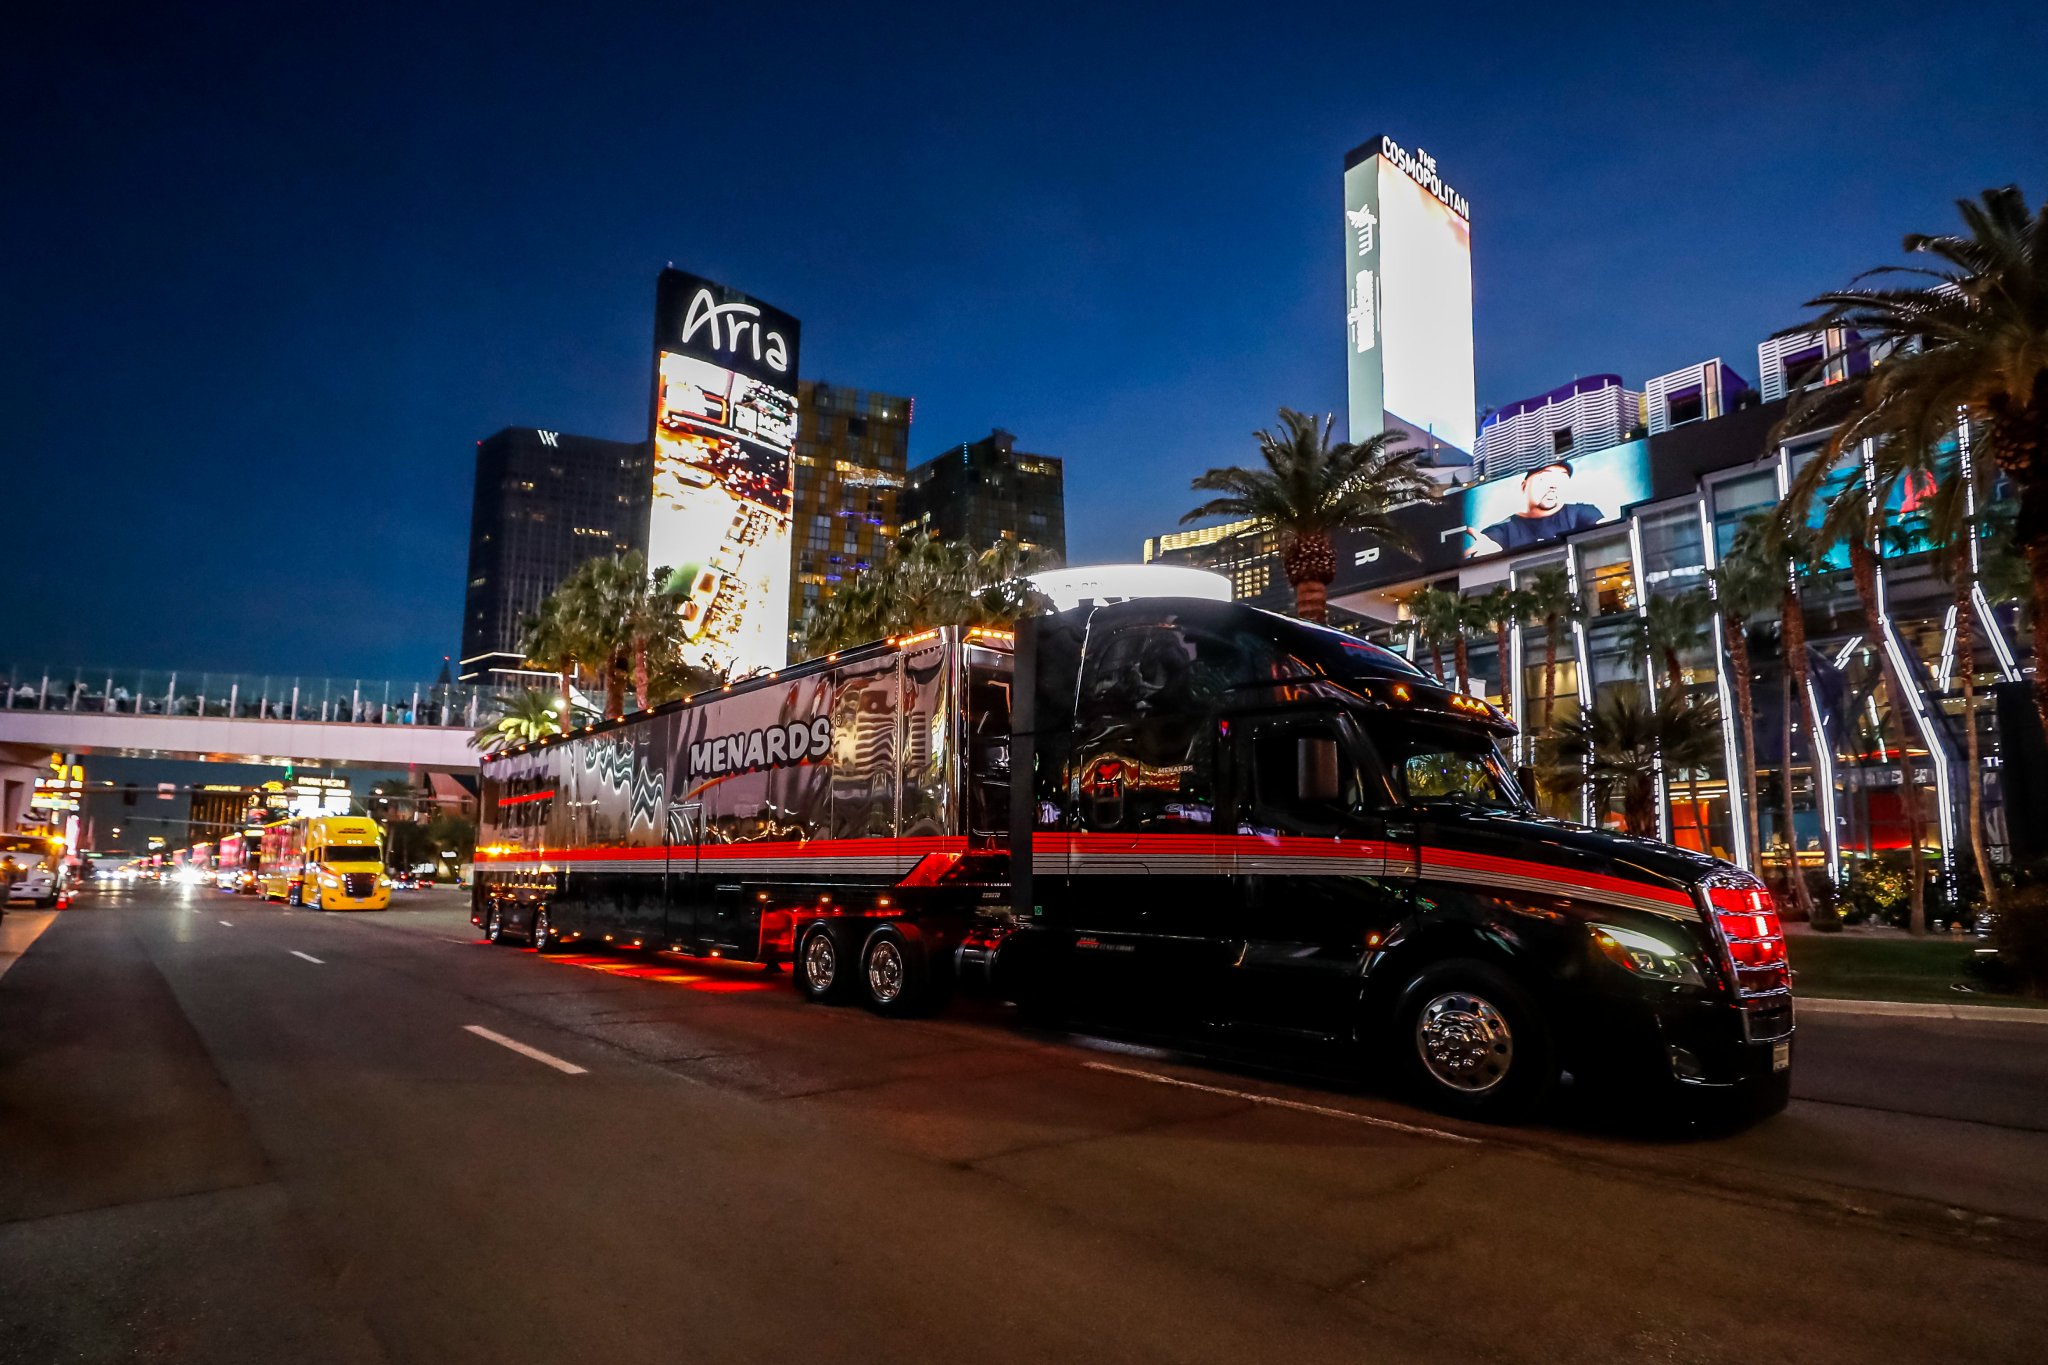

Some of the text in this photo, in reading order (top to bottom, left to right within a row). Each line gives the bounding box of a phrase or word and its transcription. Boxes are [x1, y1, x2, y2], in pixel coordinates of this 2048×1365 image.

[1382, 135, 1470, 221] COSMOPOLITAN
[1418, 147, 1437, 174] THE
[682, 288, 788, 372] Aria
[688, 715, 832, 780] MENARDS
[1157, 764, 1194, 774] MENARDS
